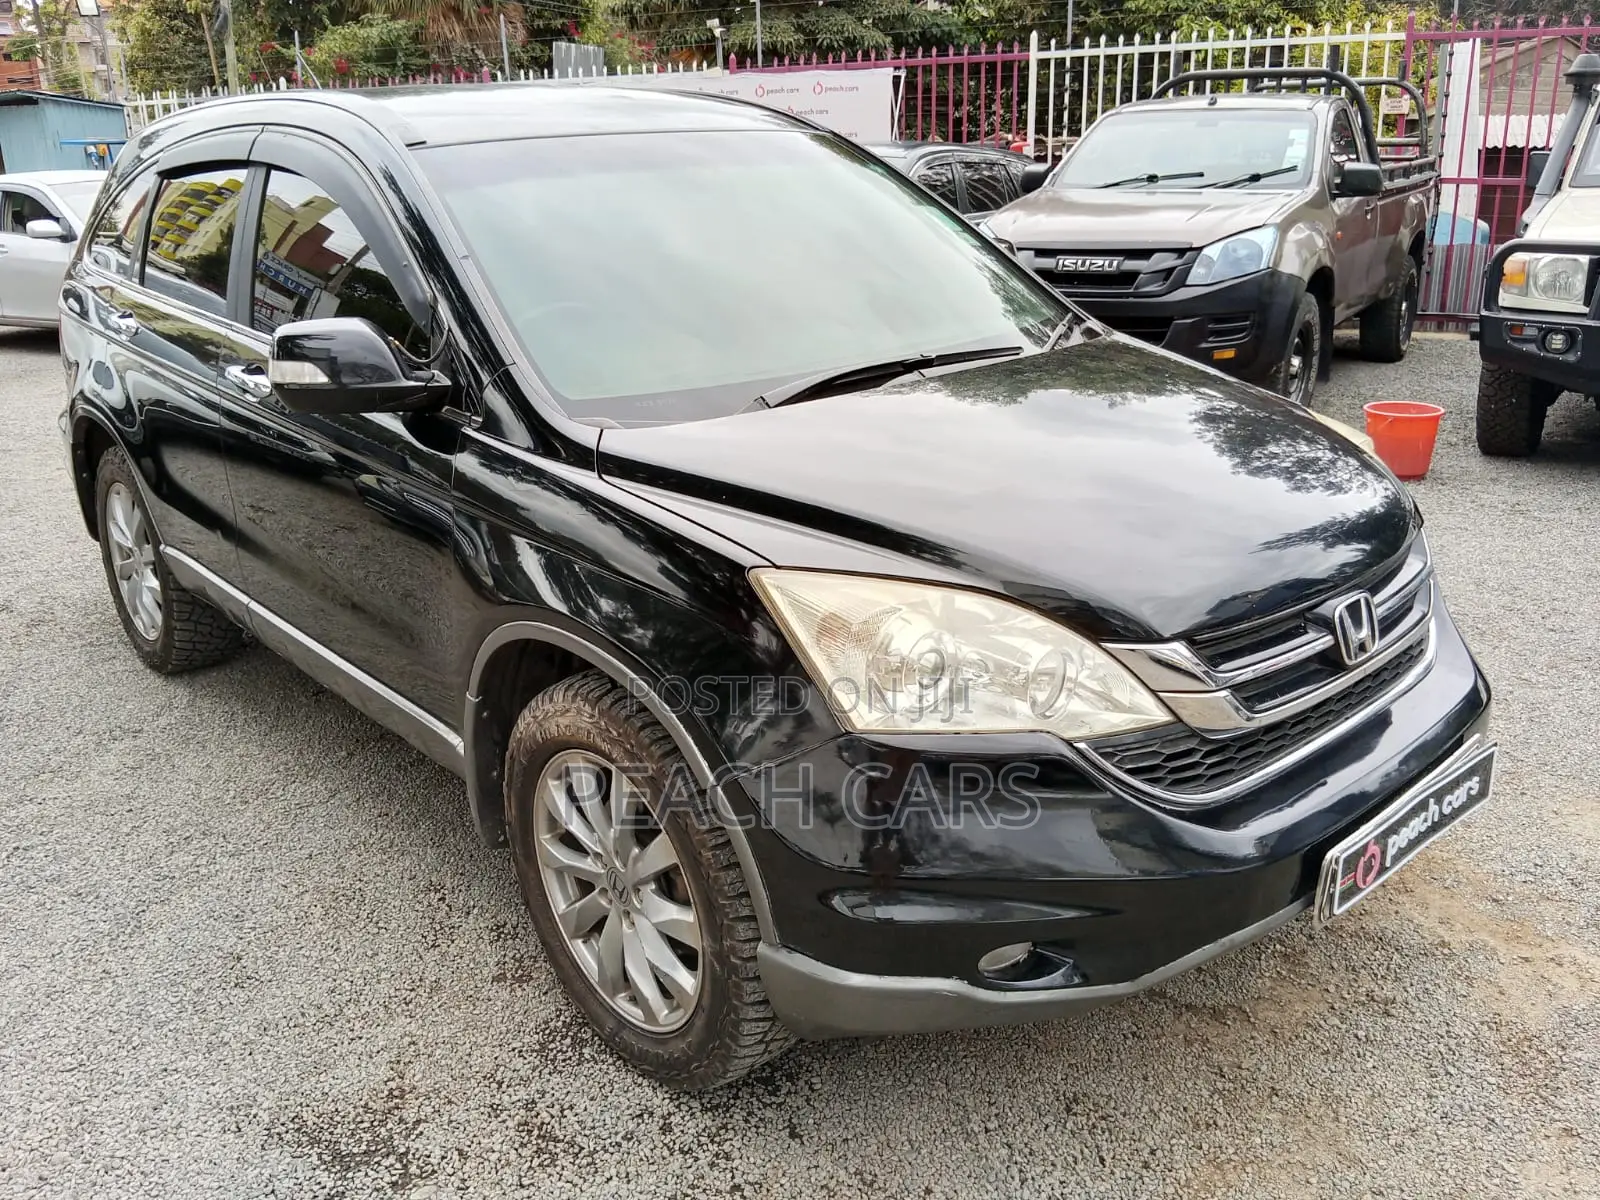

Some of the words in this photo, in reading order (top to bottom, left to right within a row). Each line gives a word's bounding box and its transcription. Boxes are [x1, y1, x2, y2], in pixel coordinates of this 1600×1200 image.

[766, 87, 785, 96] peach
[824, 85, 844, 94] peach
[1057, 259, 1118, 271] ISUZU
[1385, 798, 1439, 867] peach
[1442, 775, 1481, 815] cars
